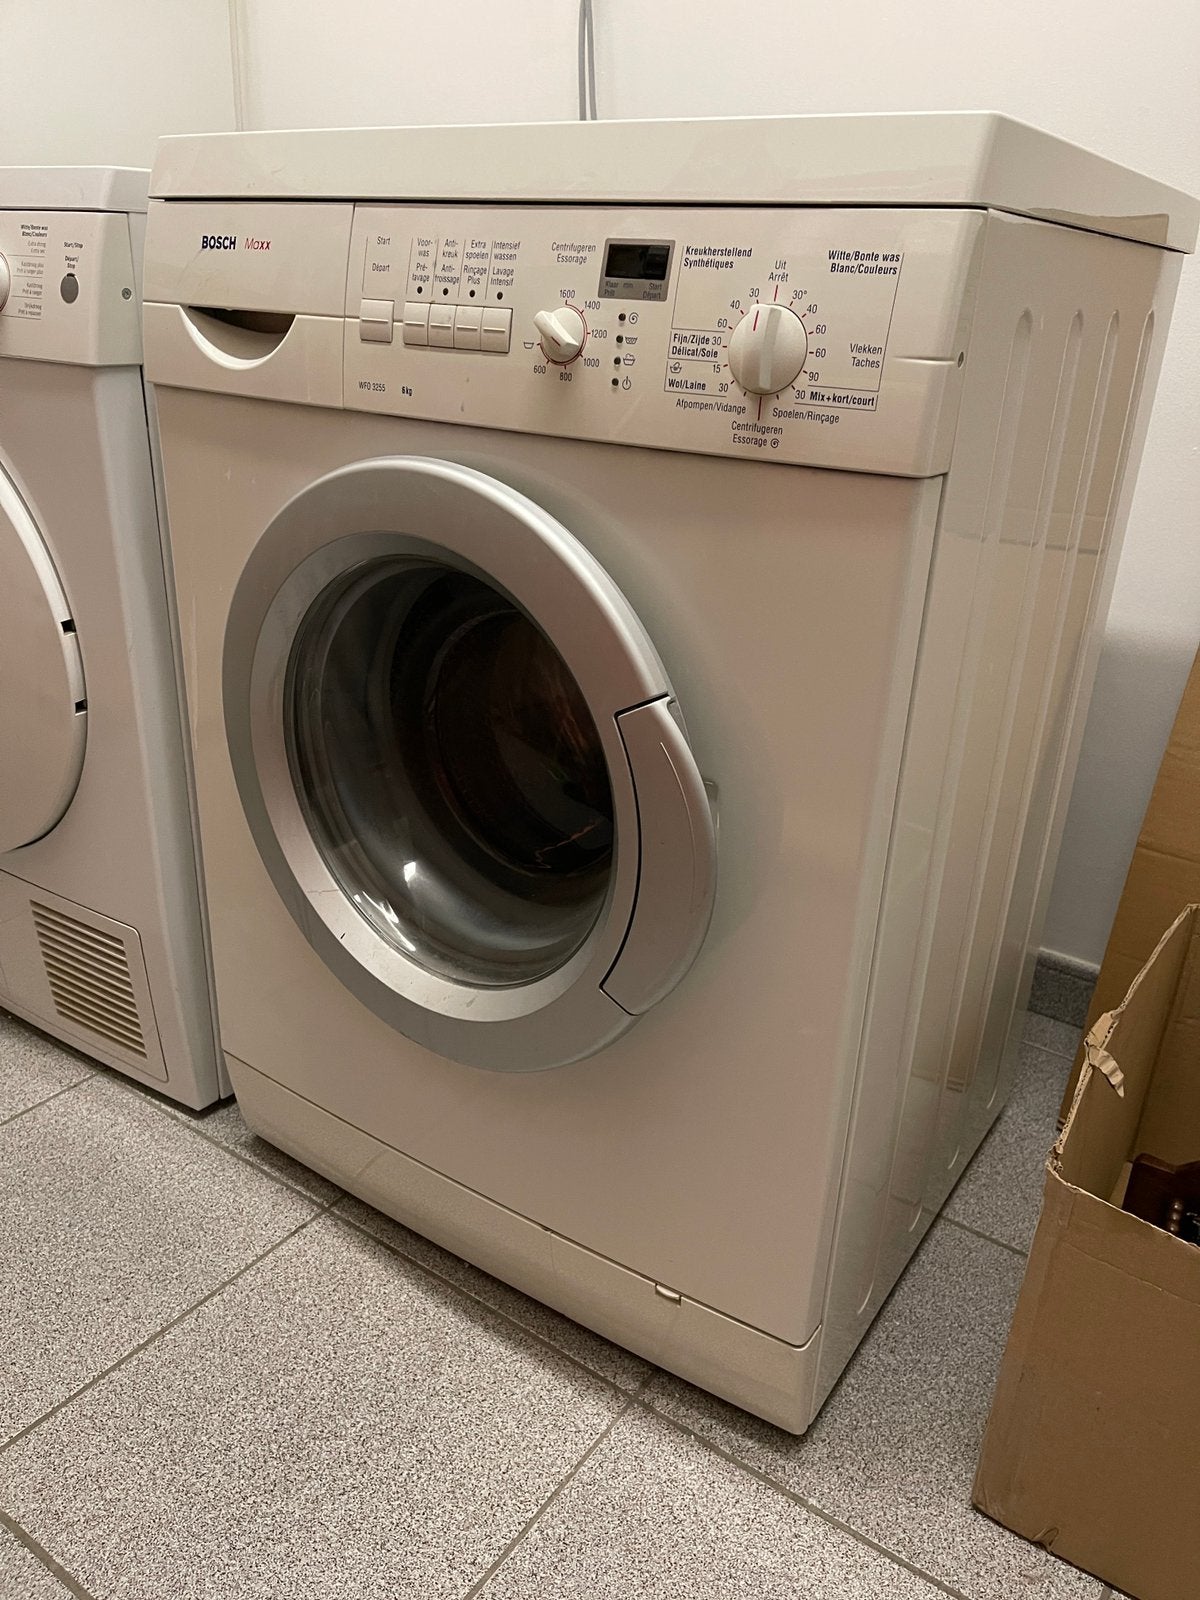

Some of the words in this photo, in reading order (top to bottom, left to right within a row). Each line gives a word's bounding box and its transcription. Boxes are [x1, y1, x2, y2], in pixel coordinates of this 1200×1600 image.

[201, 235, 237, 250] BOSCH
[377, 236, 391, 245] Start
[417, 237, 433, 247] Voor-
[444, 238, 459, 248] Anti-
[470, 239, 487, 249] Extra
[493, 240, 521, 250] Intensief
[551, 241, 597, 253] Centrifugeren
[685, 245, 753, 258] Kreukherstellend
[418, 249, 430, 257] was
[442, 249, 458, 258] kreuk
[465, 250, 489, 260] spoelen
[493, 252, 517, 261] wassen
[827, 250, 880, 262] Witte/Bonte
[882, 253, 901, 263] was
[556, 253, 588, 265] Essorage
[683, 257, 735, 270] Synthétiques
[372, 262, 390, 272] Départ
[416, 262, 428, 271] Pré-
[441, 264, 455, 273] Anti-
[774, 259, 787, 270] Uit
[830, 262, 898, 275] Blanc/Couleurs
[463, 264, 488, 277] Rinçage
[492, 266, 515, 277] Lavage
[412, 273, 430, 283] lavage
[467, 275, 481, 285] Plus
[490, 277, 514, 287] Intensif
[767, 271, 789, 283] Arrêt
[559, 289, 576, 299] 1600
[749, 287, 760, 298] 30
[584, 300, 600, 310] 1400
[730, 300, 741, 310] 40
[806, 304, 818, 314] 40
[717, 318, 728, 328] 60
[591, 329, 608, 339] 1200
[815, 324, 827, 335] 60
[673, 333, 710, 346] Fijn/Zijde
[711, 336, 722, 346] 30
[671, 345, 719, 359] Délicat/Soie
[815, 348, 827, 358] 60
[850, 343, 883, 355] Vlekken
[583, 357, 600, 368] 1000
[852, 357, 881, 369] Taches
[533, 365, 546, 375] 600
[712, 364, 721, 374] 15
[559, 371, 573, 382] 800
[808, 371, 820, 382] 90
[372, 382, 386, 392] 3255
[668, 378, 707, 391] Wol/Laine
[718, 383, 729, 393] 30
[795, 390, 806, 400] 30
[810, 391, 875, 407] Mix+kort/court
[676, 399, 747, 416] Afpompen/Vidange
[772, 407, 840, 425] Spoelen/Rinçage
[731, 420, 784, 436] Centrifugeren
[732, 433, 768, 448] Essorage
